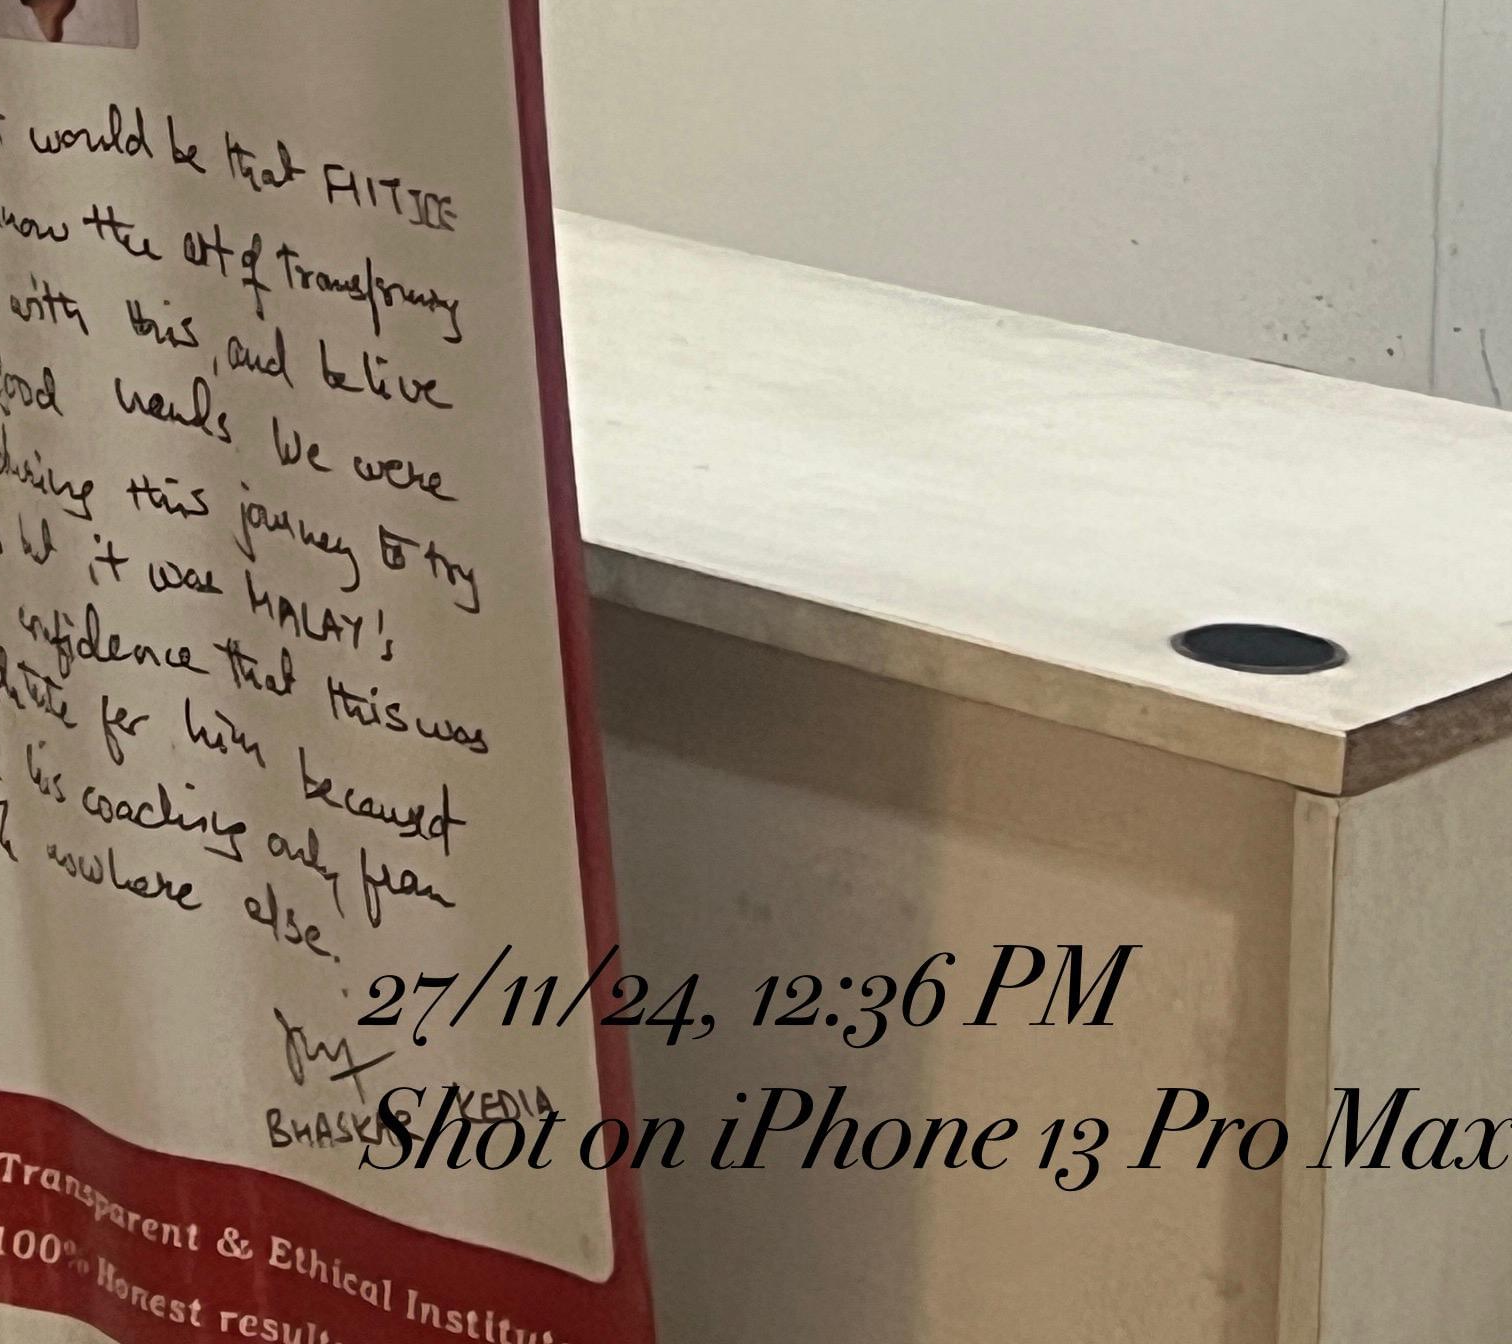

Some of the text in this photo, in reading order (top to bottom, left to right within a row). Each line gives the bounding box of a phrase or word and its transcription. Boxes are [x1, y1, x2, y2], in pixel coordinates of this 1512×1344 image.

[29, 103, 153, 158] would
[167, 115, 206, 174] be
[225, 131, 305, 192] that
[126, 474, 209, 518] this
[90, 534, 129, 586] it
[82, 781, 247, 862] coaching
[97, 1257, 201, 1328] Honest
[217, 1226, 254, 1260] &
[270, 1234, 392, 1312] Ethical
